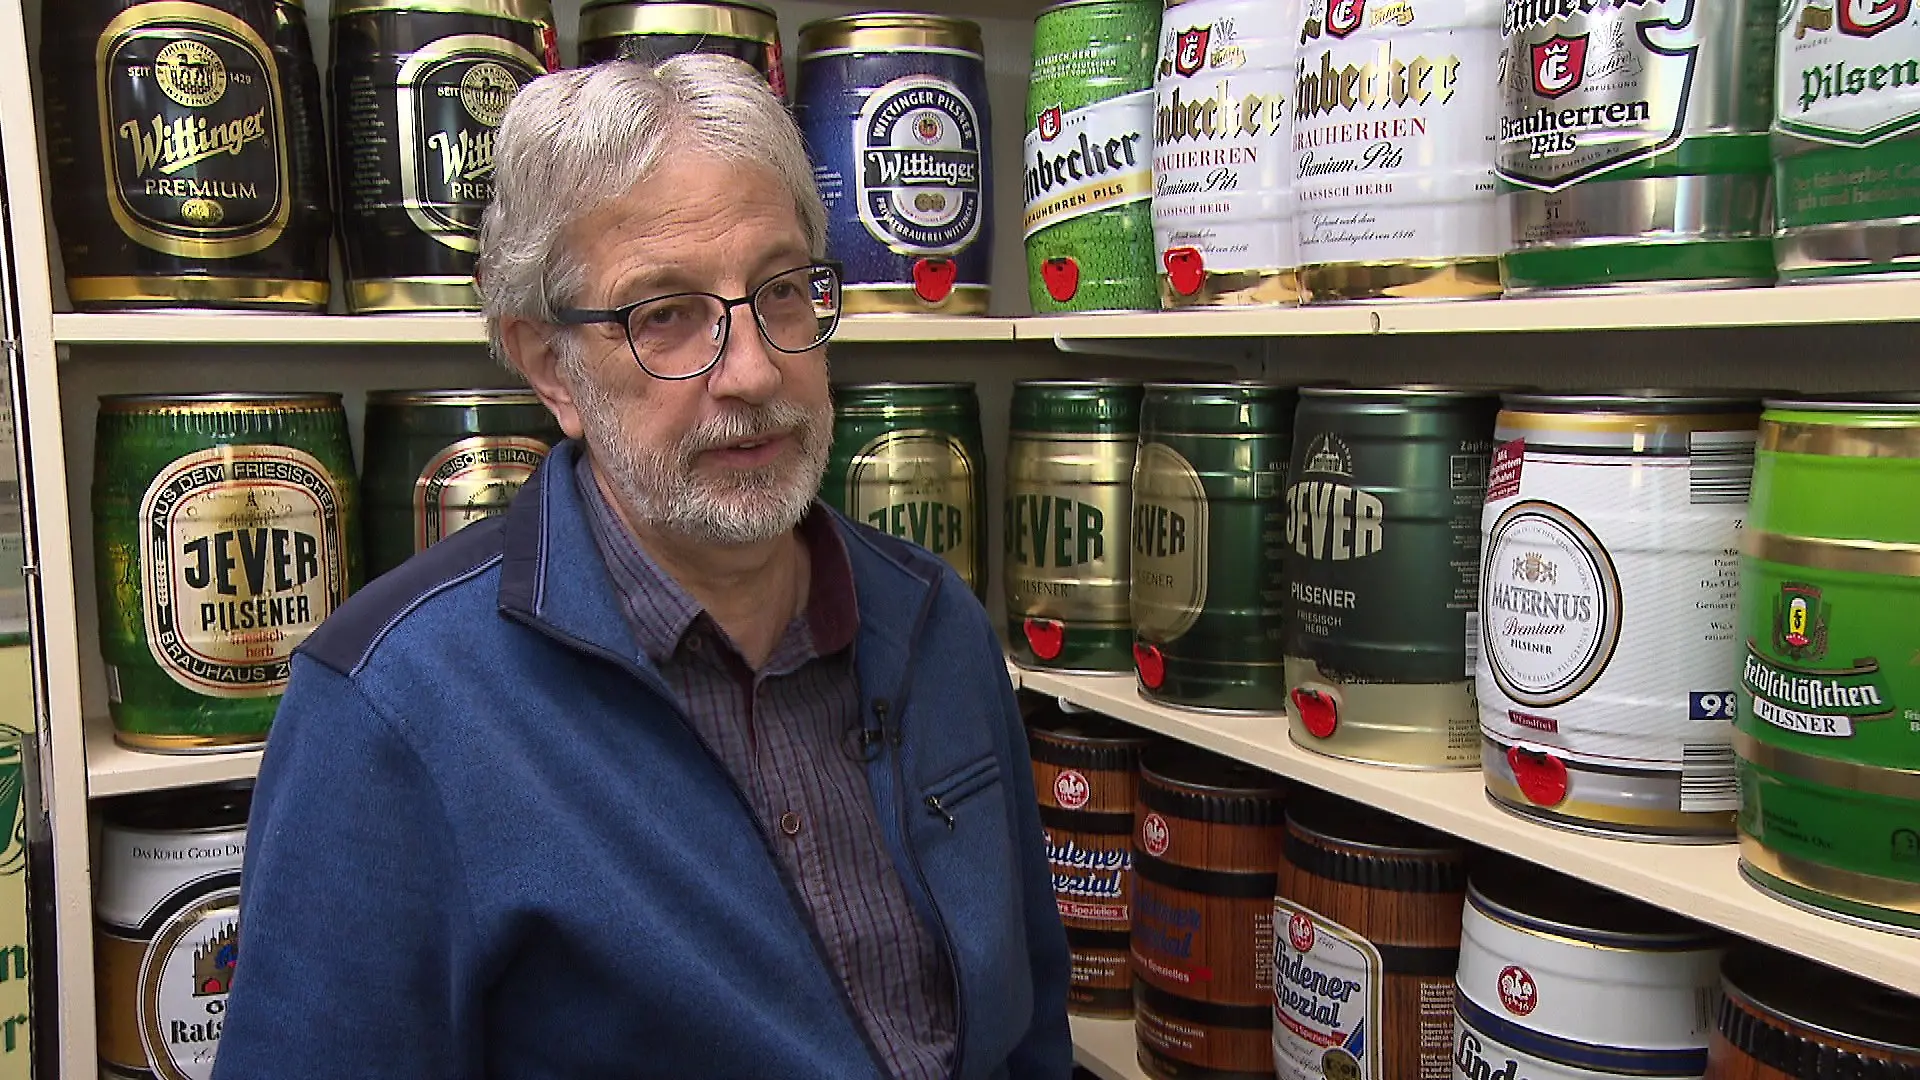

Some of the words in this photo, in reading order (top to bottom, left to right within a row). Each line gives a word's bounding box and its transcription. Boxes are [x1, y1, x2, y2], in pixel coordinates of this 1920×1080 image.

[128, 66, 150, 77] SEIT
[229, 72, 251, 85] 1429
[1293, 39, 1461, 121] inbecker
[437, 86, 460, 97] SEIT
[872, 91, 934, 138] WITTINGER
[1155, 80, 1286, 148] inbecker
[1500, 100, 1650, 142] Brauherren
[119, 106, 265, 178] Wittinger
[1155, 147, 1258, 173] RAUHERREN
[1358, 141, 1403, 170] Pils
[1529, 132, 1577, 158] Pils
[867, 151, 976, 186] Wittinger
[1204, 167, 1238, 194] Pils
[145, 179, 258, 199] PREMIUM
[1024, 193, 1086, 229] RAUHERREN
[1093, 182, 1124, 199] PILS
[1299, 186, 1349, 201] LASSISCH
[1156, 205, 1195, 218] LASSISCH
[153, 488, 177, 529] AUS
[178, 465, 225, 492] DEM
[234, 462, 334, 519] FRIESISCHEN
[1286, 481, 1384, 561] JEVER
[183, 527, 319, 596] JEVER
[200, 595, 311, 632] PILSENER
[1290, 581, 1356, 610] PILSENER
[1491, 581, 1592, 624] MATERNUS
[1502, 615, 1566, 638] Premium
[160, 630, 266, 683] BRAUHAUS
[275, 663, 290, 678] Z
[1510, 638, 1553, 656] PILSENER
[1761, 702, 1837, 734] PILSNER
[1273, 935, 1361, 1003] Lindener
[1275, 972, 1342, 1029] Spezial
[1455, 1029, 1530, 1080] Lind
